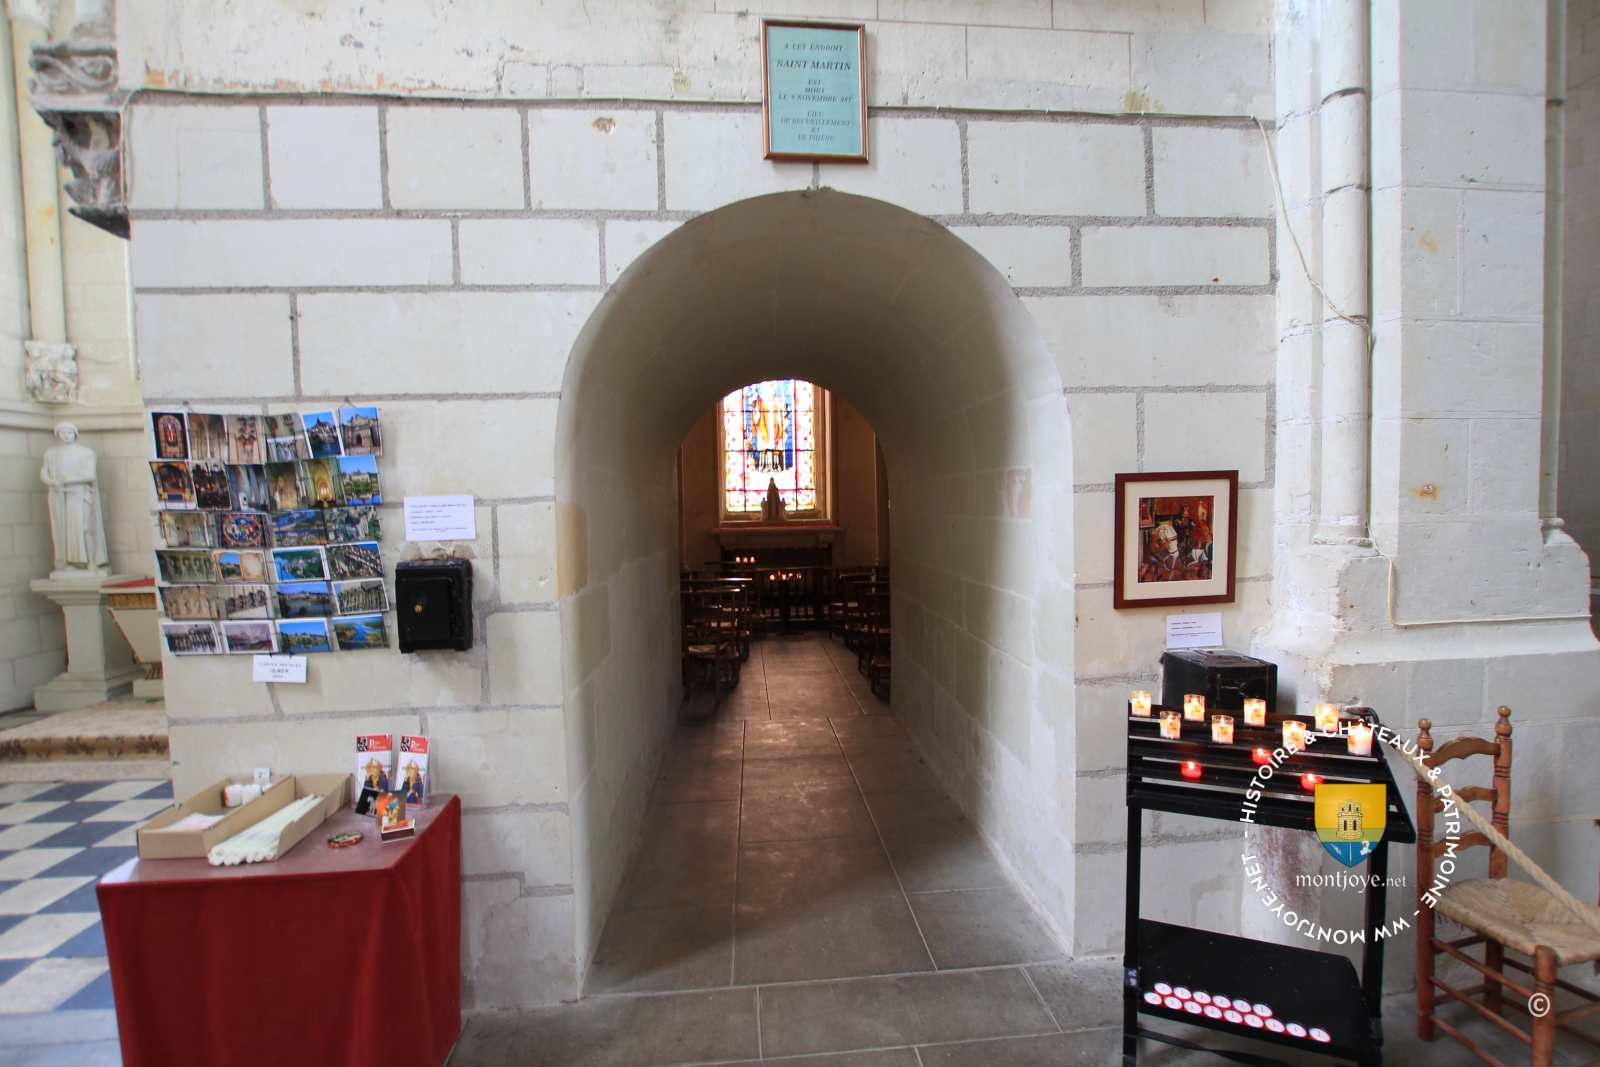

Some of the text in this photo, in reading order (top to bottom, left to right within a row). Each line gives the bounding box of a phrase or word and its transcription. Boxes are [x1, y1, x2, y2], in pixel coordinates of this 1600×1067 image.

[809, 43, 843, 52] ENDROIT
[777, 59, 851, 71] SAINT MARTIN
[797, 95, 838, 103] NOVEMBRE
